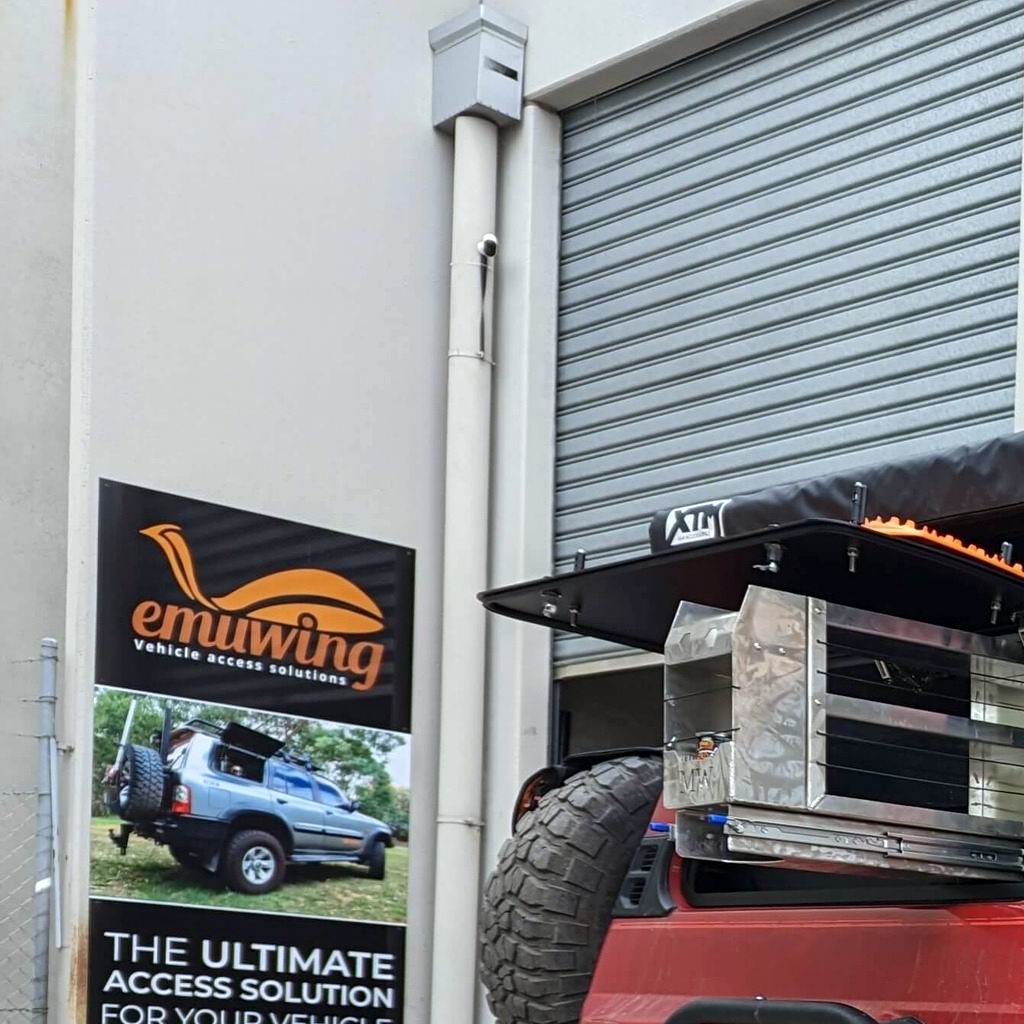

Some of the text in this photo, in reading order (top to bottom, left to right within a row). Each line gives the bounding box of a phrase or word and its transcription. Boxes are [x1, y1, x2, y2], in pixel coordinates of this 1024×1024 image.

[131, 600, 385, 691] emuwing
[134, 638, 348, 686] Vehicle access solutions
[103, 931, 395, 981] THE ULTIMATE
[102, 969, 394, 1009] ACCESS SOLUTION
